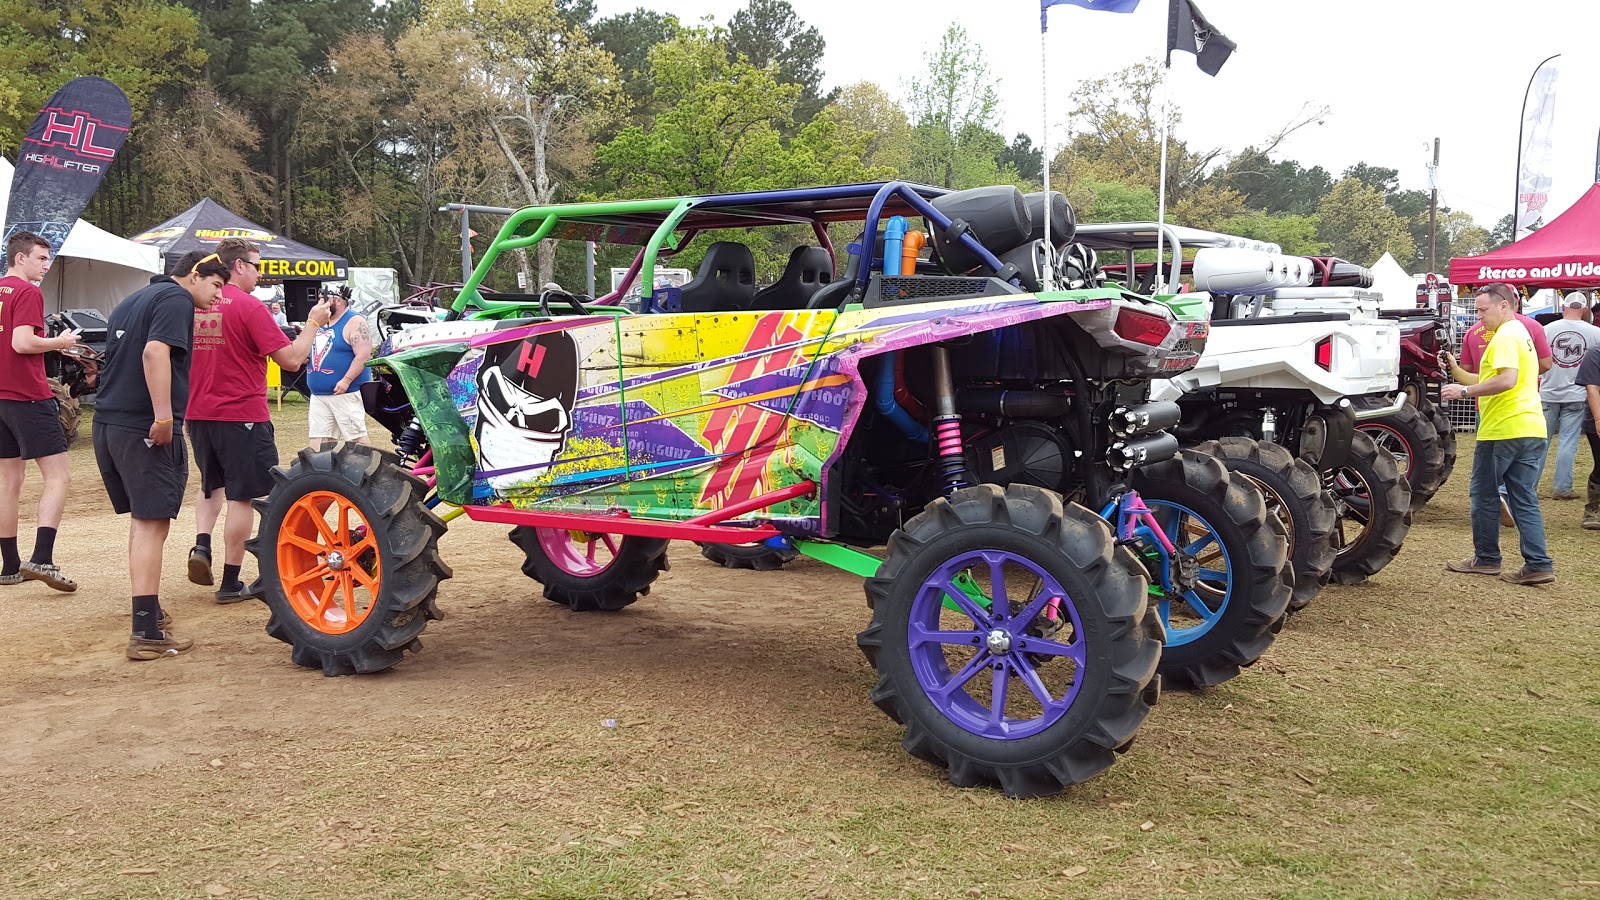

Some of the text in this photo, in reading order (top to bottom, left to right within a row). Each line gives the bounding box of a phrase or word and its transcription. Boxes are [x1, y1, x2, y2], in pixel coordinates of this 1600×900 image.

[42, 112, 115, 157] HL
[25, 153, 100, 174] HIGHLIFTER
[259, 260, 335, 276] TER.COM
[1478, 266, 1527, 279] Stereo
[1530, 263, 1562, 278] and
[1555, 338, 1582, 359] CM
[516, 341, 547, 378] H
